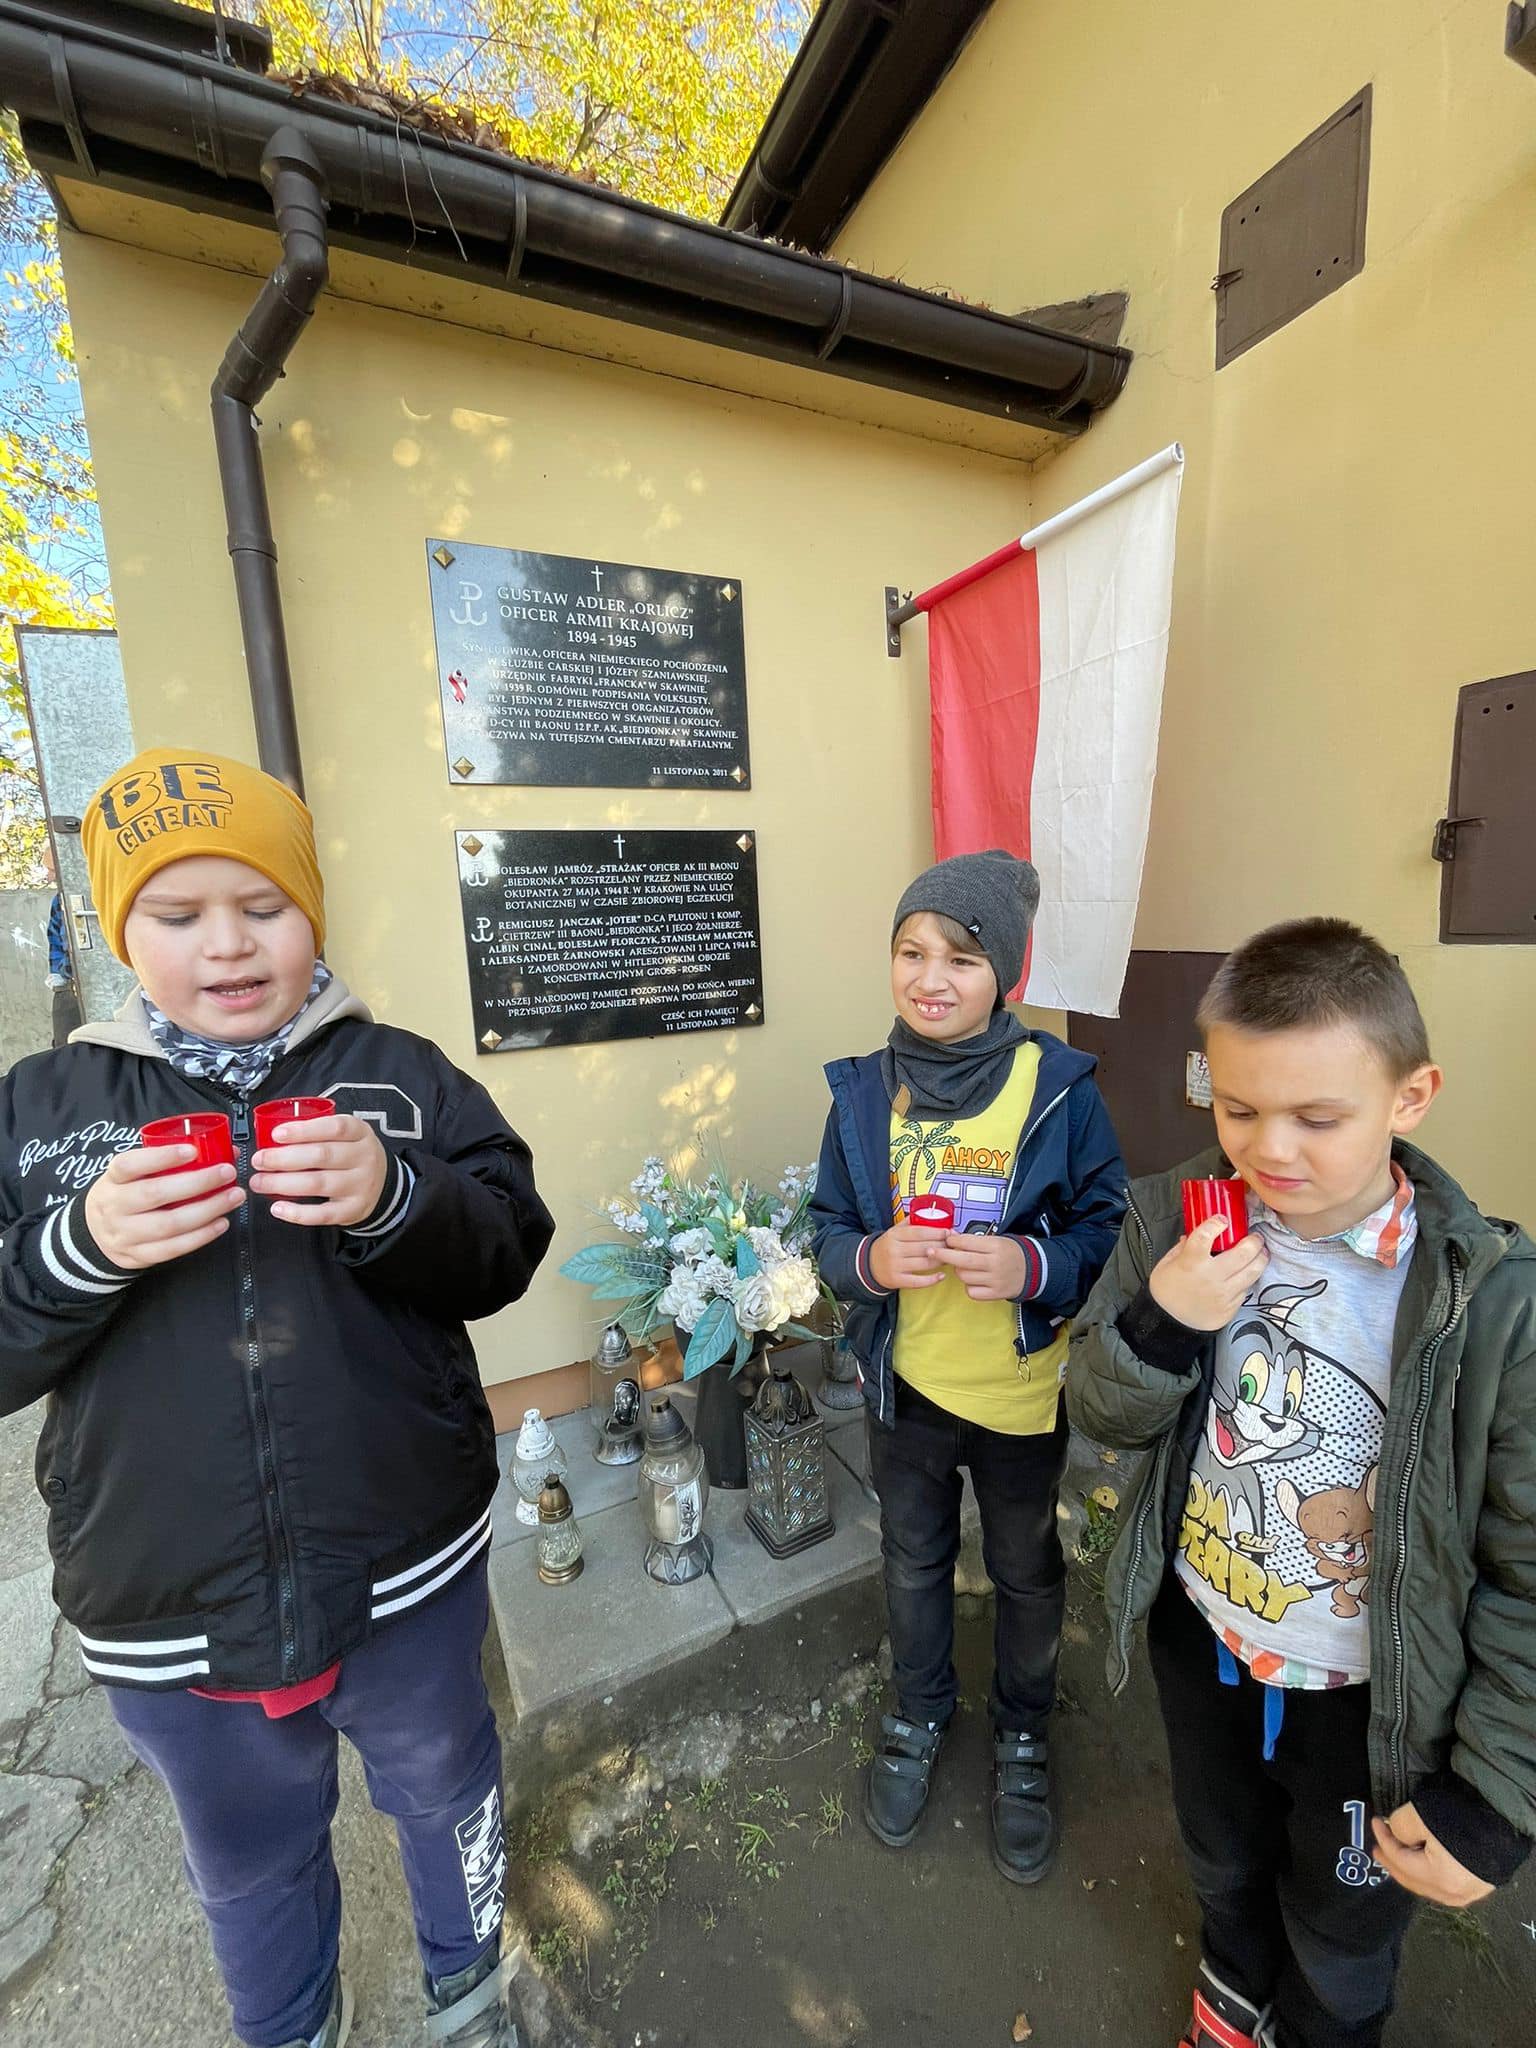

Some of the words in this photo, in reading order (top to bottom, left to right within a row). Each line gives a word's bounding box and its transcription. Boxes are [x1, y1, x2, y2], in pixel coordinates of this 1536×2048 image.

[497, 586, 568, 606] GUSTAW
[576, 595, 626, 613] ADLER
[500, 605, 559, 623] OFICER
[566, 612, 613, 629] ARMII
[620, 617, 694, 640] KRAJOWEJ
[462, 642, 483, 653] SYN
[542, 649, 586, 662] OFICERA
[590, 653, 660, 668] NIEMIECKIEGO
[663, 660, 728, 674] POCHODZENIA
[487, 657, 498, 665] W
[547, 662, 594, 676] CARSKIEJ
[605, 665, 639, 678] JÓZEFY
[641, 670, 710, 684] SZANIAWSKIEJ.
[489, 681, 500, 690] W
[592, 688, 650, 701] PODPISANIA
[654, 692, 711, 705] VOLKSLISTY.
[551, 674, 593, 685] FABRYKI
[648, 681, 658, 690] W
[660, 682, 708, 694] SKAWINIE.
[511, 695, 553, 706] JEDNYM
[556, 698, 564, 707] Z
[567, 698, 628, 711] PIERWSZYCH
[631, 702, 714, 716] ORGANIZATORÓW
[490, 718, 515, 728] D-CY
[519, 720, 531, 729] III
[535, 720, 571, 731] BAONU
[604, 724, 617, 733] AK
[681, 728, 690, 737] W
[693, 729, 739, 739] SKAWINIE.
[534, 709, 609, 721] PODZIEMNEGO
[612, 713, 621, 722] W
[624, 713, 671, 725] SKAWINIE
[680, 717, 722, 728] OKOLICY.
[530, 732, 546, 741] NA
[548, 732, 604, 744] TUTEJSZYM
[608, 735, 666, 746] CMENTARZU
[669, 739, 734, 750] PARAFIALNYM.
[652, 766, 660, 775] 11
[664, 767, 710, 776] LISTOPADA
[712, 768, 728, 777] 2011
[99, 762, 234, 831] BE
[116, 803, 232, 856] GREAT
[496, 865, 548, 875] BOLESŁAW
[554, 863, 593, 875] JAMRÓZ
[649, 863, 680, 872] OFICER
[683, 863, 696, 871] AK
[698, 862, 707, 871] III
[710, 862, 739, 871] BAONU
[571, 875, 641, 885] ROZSTRZELANY
[643, 874, 671, 883] PRZEZ
[673, 872, 734, 882] NIEMIECKIEGO
[504, 888, 559, 899] OKUPANTA
[562, 887, 572, 897] 27
[575, 886, 601, 897] MAJA
[632, 886, 641, 894] W
[644, 883, 691, 893] KRAKOWIE
[693, 883, 706, 892] NA
[709, 882, 733, 891] ULICY
[505, 899, 576, 910] BOTANICZNEJ
[580, 898, 590, 907] W
[593, 897, 628, 906] CZASIE
[631, 895, 683, 905] ZBIOROWEJ
[687, 893, 734, 903] EGZEKUCJI
[498, 919, 555, 930] REMIGIUSZ
[559, 917, 603, 928] JANCZAK
[644, 914, 666, 923] D-CA
[668, 911, 708, 922] PLUTONU
[717, 910, 743, 919] KOMP.
[557, 929, 567, 938] III
[570, 927, 604, 937] BAONU
[672, 923, 693, 933] JEGO
[488, 943, 519, 954] ALBIN
[557, 939, 608, 949] BOLESŁAW
[611, 936, 660, 946] FLORCZYK,
[661, 932, 711, 943] STANISŁAW
[713, 930, 754, 940] MARCZYK
[488, 953, 560, 966] ALEKSANDER
[563, 948, 625, 960] ŻARNOWSKI
[629, 944, 696, 956] ARESZTOWANI
[705, 942, 730, 951] LIPCA
[527, 960, 608, 975] ZAMORDOWANI
[611, 959, 621, 968] W
[624, 954, 695, 967] HITLEROWSKIM
[697, 952, 731, 962] OBOZIE
[543, 969, 644, 984] KONCENTRACYJNYM
[484, 1000, 494, 1008] W
[497, 997, 531, 1008] NASZEJ
[534, 991, 589, 1004] NARODOWEJ
[592, 988, 628, 999] PAMIĘCI
[682, 983, 695, 991] DO
[697, 980, 726, 989] KOŃCA
[727, 978, 755, 987] WIERNI
[508, 1005, 562, 1017] PRZYSIĘDZE
[565, 1002, 588, 1013] JAKO
[640, 994, 679, 1005] PAŃSTWA
[682, 989, 738, 1001] PODZIEMNEGO
[665, 1023, 673, 1031] 11
[676, 1019, 718, 1030] LISTOPADA
[720, 1017, 736, 1026] 2012
[688, 1009, 702, 1018] ICH
[18, 1131, 80, 1178] Best
[79, 1120, 143, 1152] Play
[942, 1145, 1011, 1170] AHOY
[1183, 1469, 1231, 1540] OM
[1236, 1532, 1281, 1552] and
